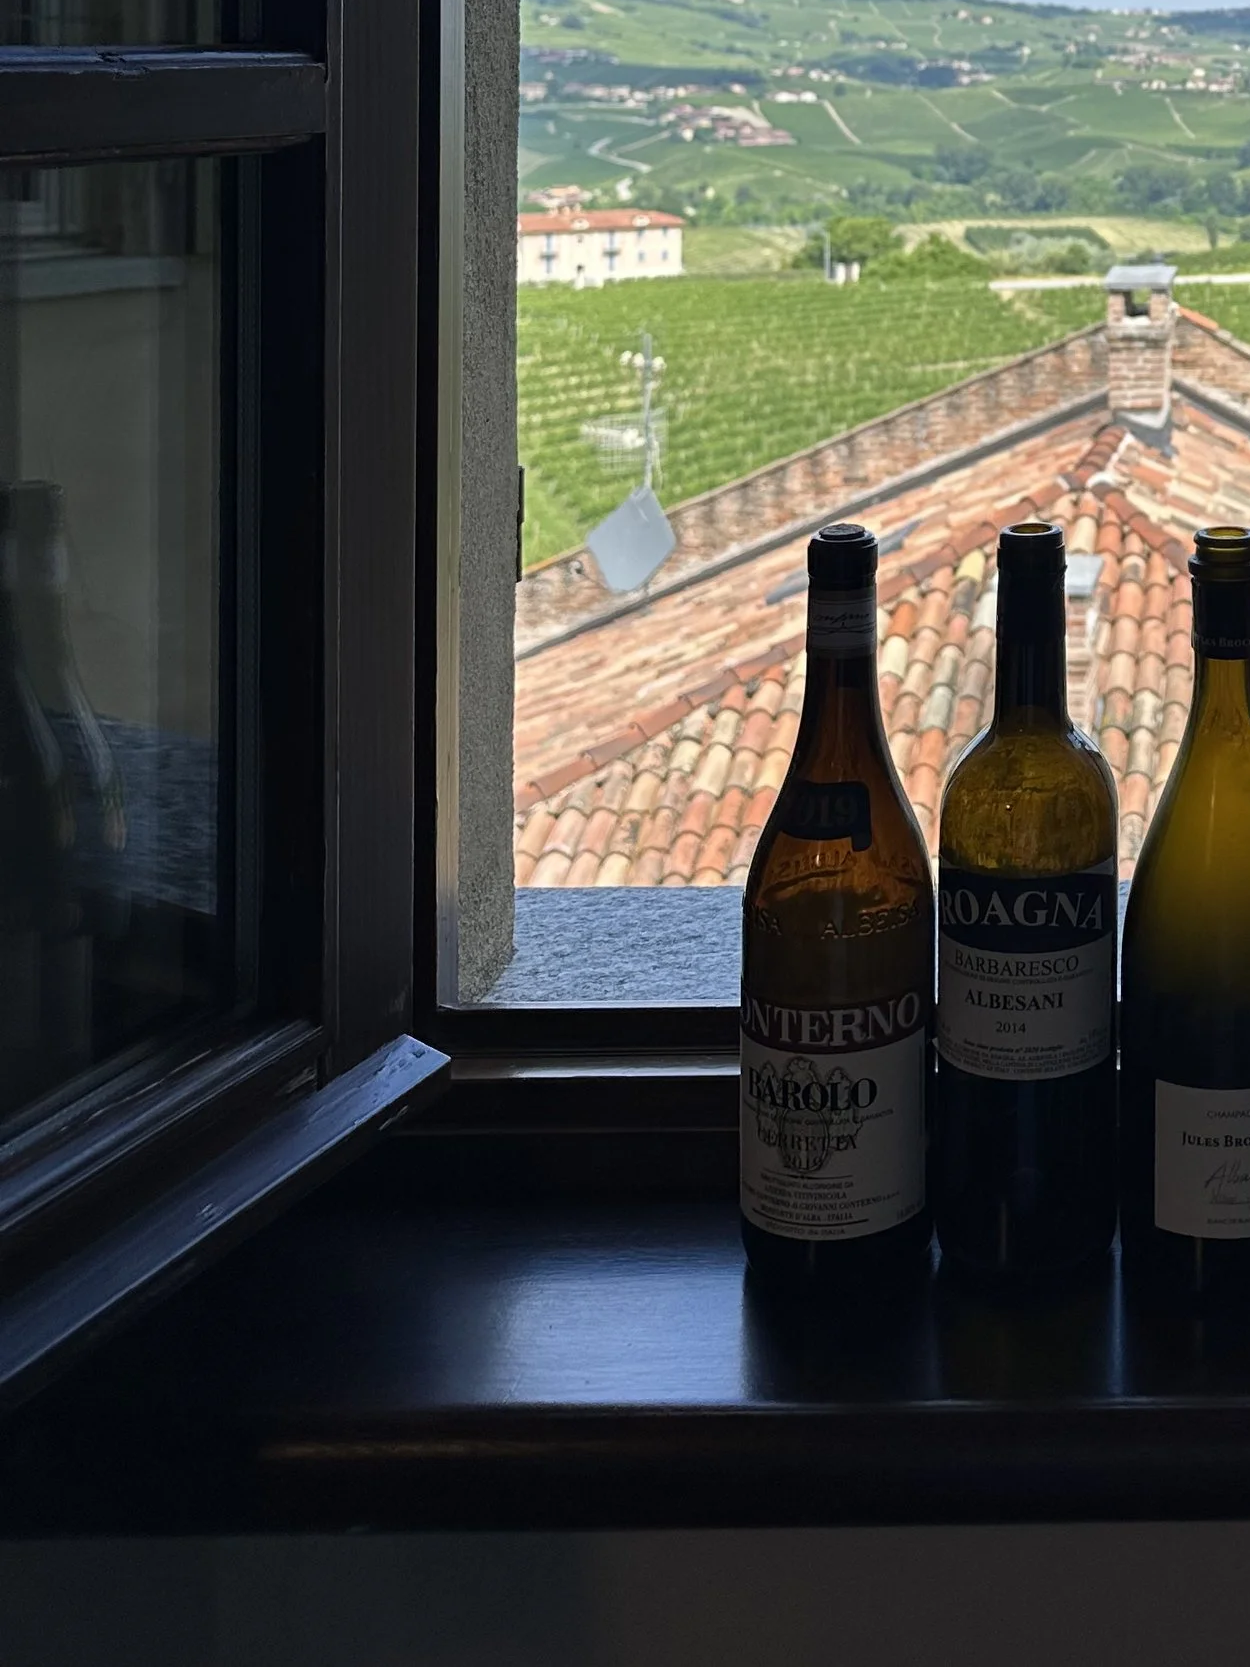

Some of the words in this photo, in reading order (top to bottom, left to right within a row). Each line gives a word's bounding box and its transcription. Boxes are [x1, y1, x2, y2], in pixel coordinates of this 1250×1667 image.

[940, 888, 1104, 930] ROAGNA
[955, 950, 1079, 977] BARBARESCO
[965, 989, 1064, 1012] ALBESANI
[740, 991, 919, 1047] ONTERNO
[995, 1021, 1026, 1034] 2014
[749, 1066, 878, 1112] BAROLO
[1181, 1131, 1220, 1147] JULES
